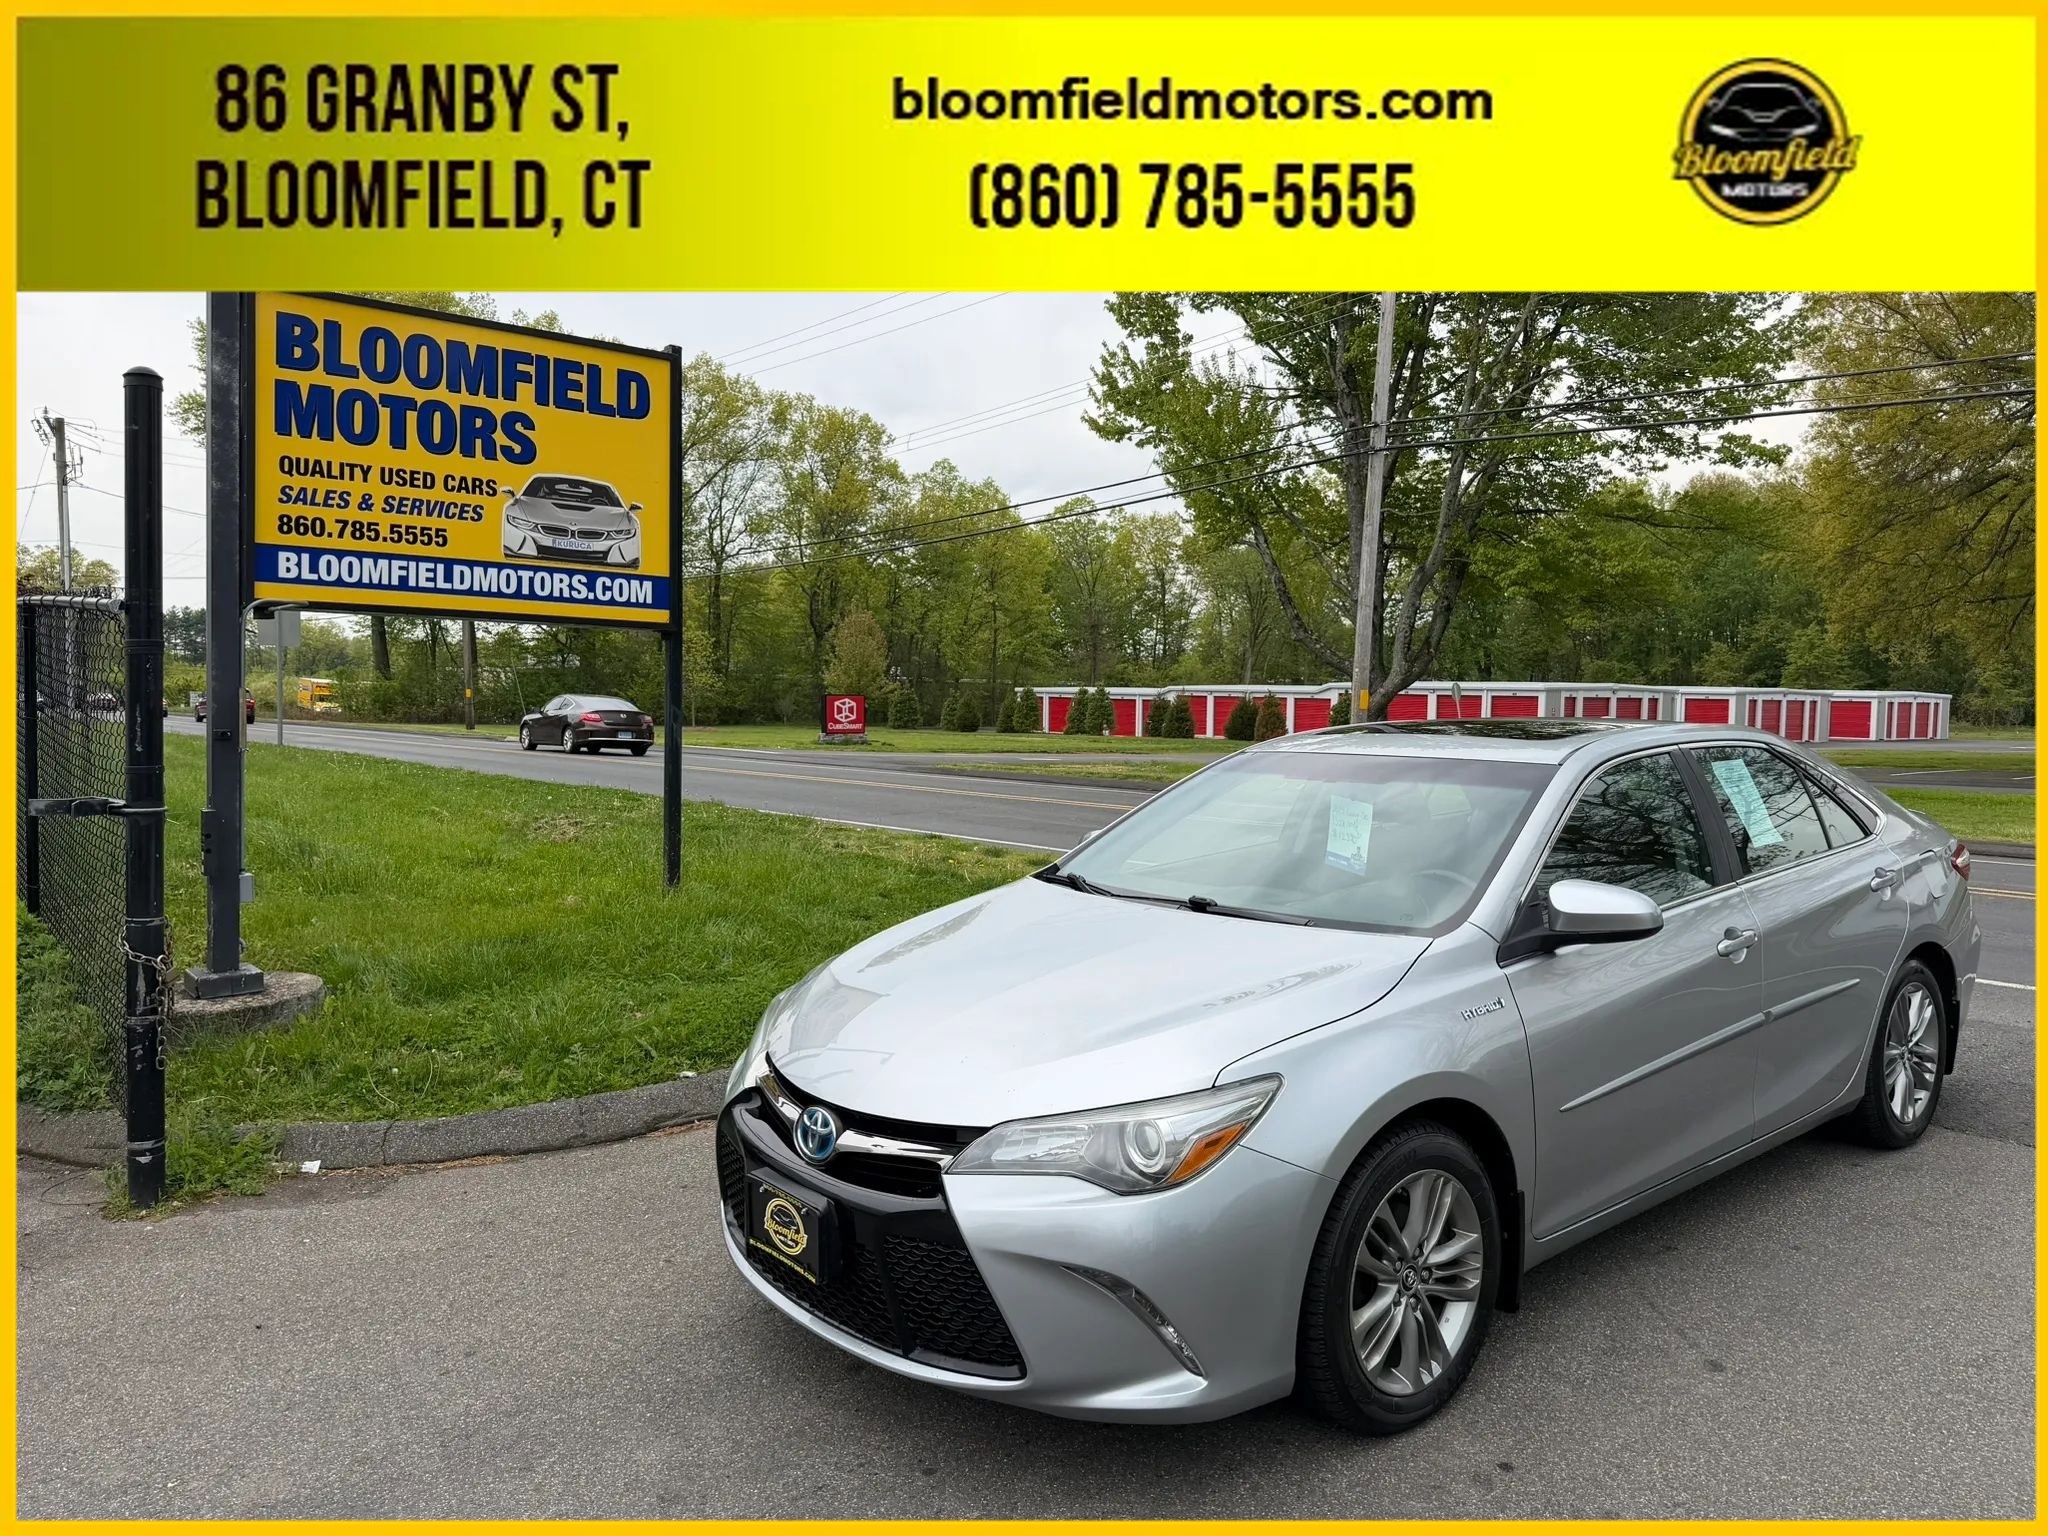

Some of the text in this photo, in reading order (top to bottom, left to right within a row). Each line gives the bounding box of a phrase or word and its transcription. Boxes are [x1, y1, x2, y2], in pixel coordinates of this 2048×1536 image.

[275, 311, 651, 420] BLOOMFIELD
[274, 379, 537, 465] MOTORS
[279, 455, 498, 497] QUALITY USED CARS
[278, 485, 484, 523] SALES & SERVICES
[277, 514, 448, 547] 860.785.5555
[557, 540, 592, 550] KURUCA
[277, 551, 653, 604] BLOOMFIELDMOTORS.COM
[1461, 998, 1502, 1020] HYBRID
